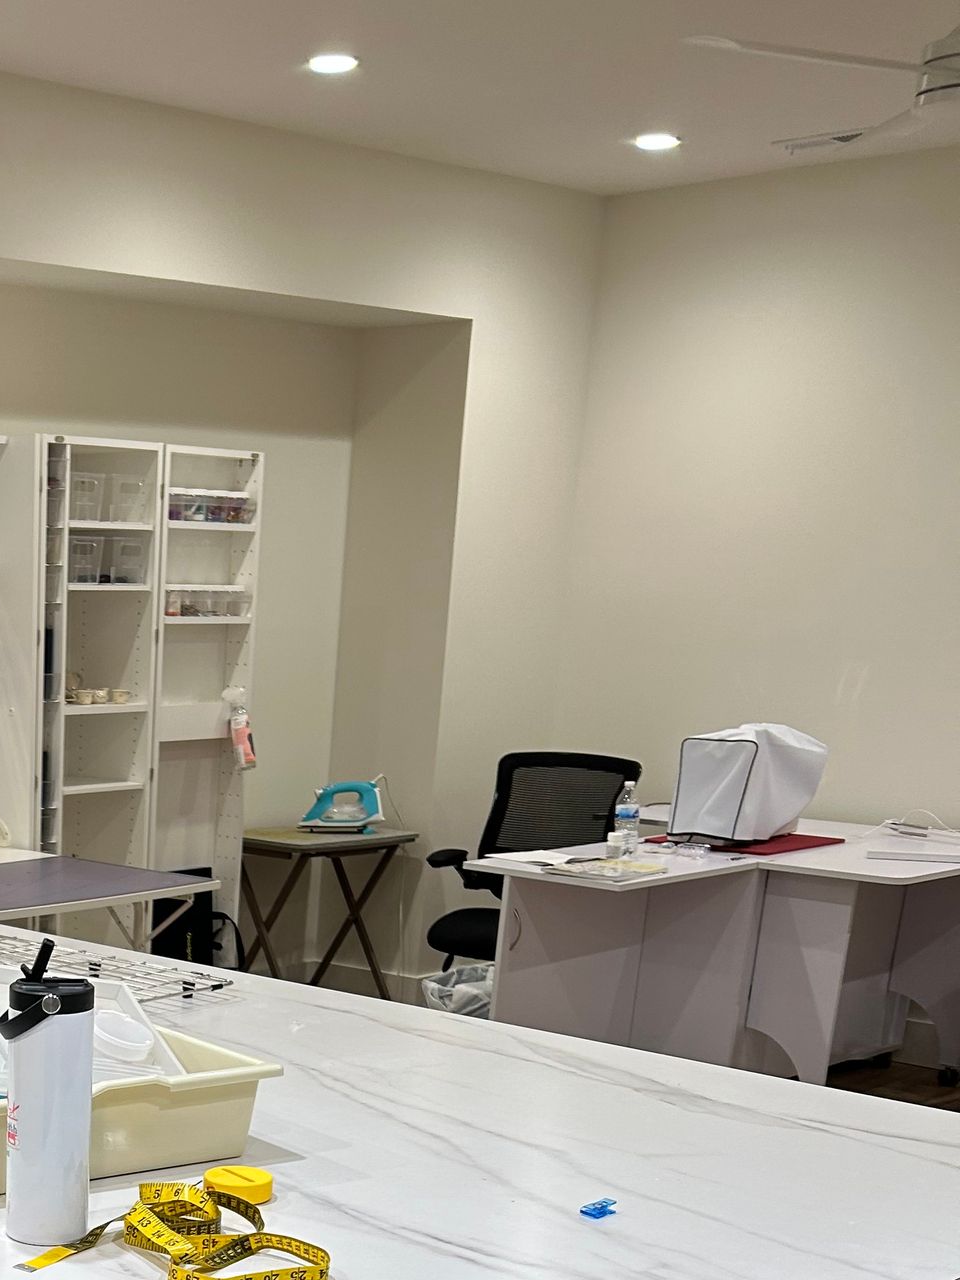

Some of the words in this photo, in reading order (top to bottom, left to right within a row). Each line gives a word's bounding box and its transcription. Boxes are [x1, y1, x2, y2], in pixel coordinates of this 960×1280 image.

[153, 1189, 161, 1200] 5
[173, 1188, 182, 1198] 6
[126, 1225, 140, 1239] 35
[136, 1216, 152, 1228] 13
[151, 1229, 165, 1240] 14
[202, 1238, 219, 1250] 45
[319, 1269, 326, 1280] 4
